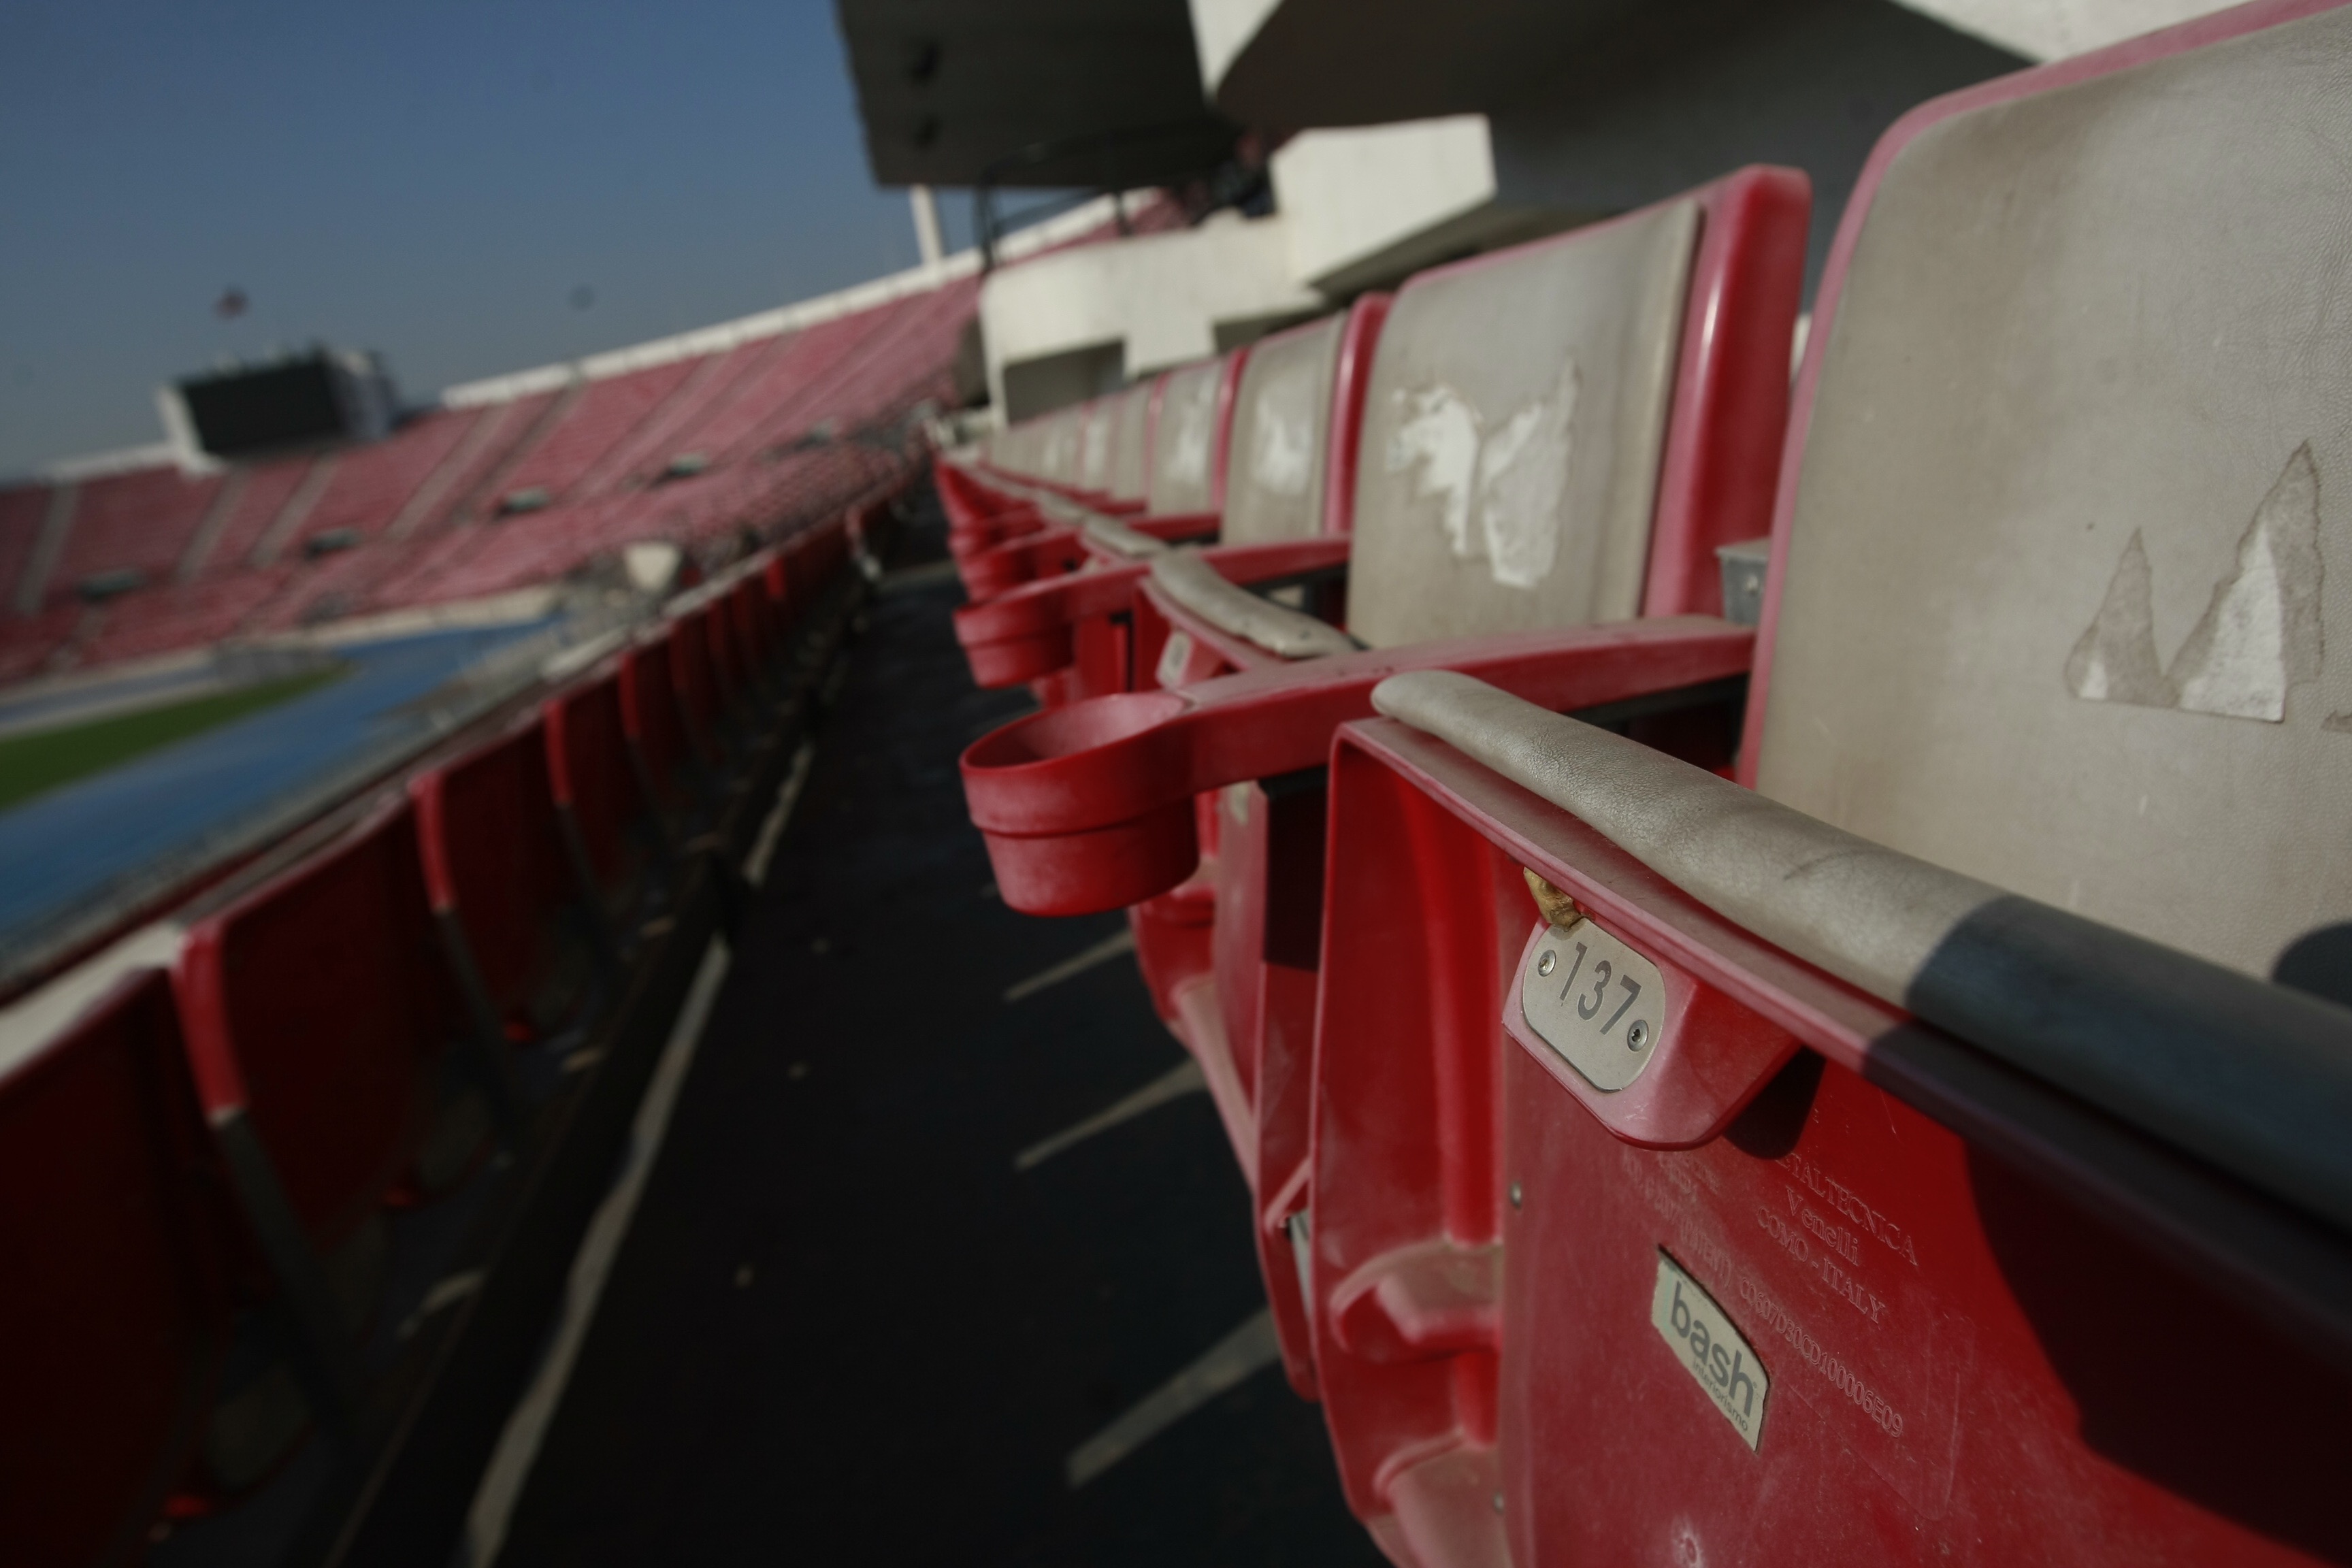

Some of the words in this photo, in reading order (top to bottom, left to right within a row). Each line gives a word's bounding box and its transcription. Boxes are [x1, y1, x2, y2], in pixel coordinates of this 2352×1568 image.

[1559, 941, 1642, 1036] 137
[1757, 1206, 1808, 1262] COMO
[1821, 1257, 1886, 1324] ITALY
[1785, 1186, 1859, 1267] Venelli
[1671, 1280, 1754, 1418] bash
[1693, 1357, 1749, 1432] interiorismo
